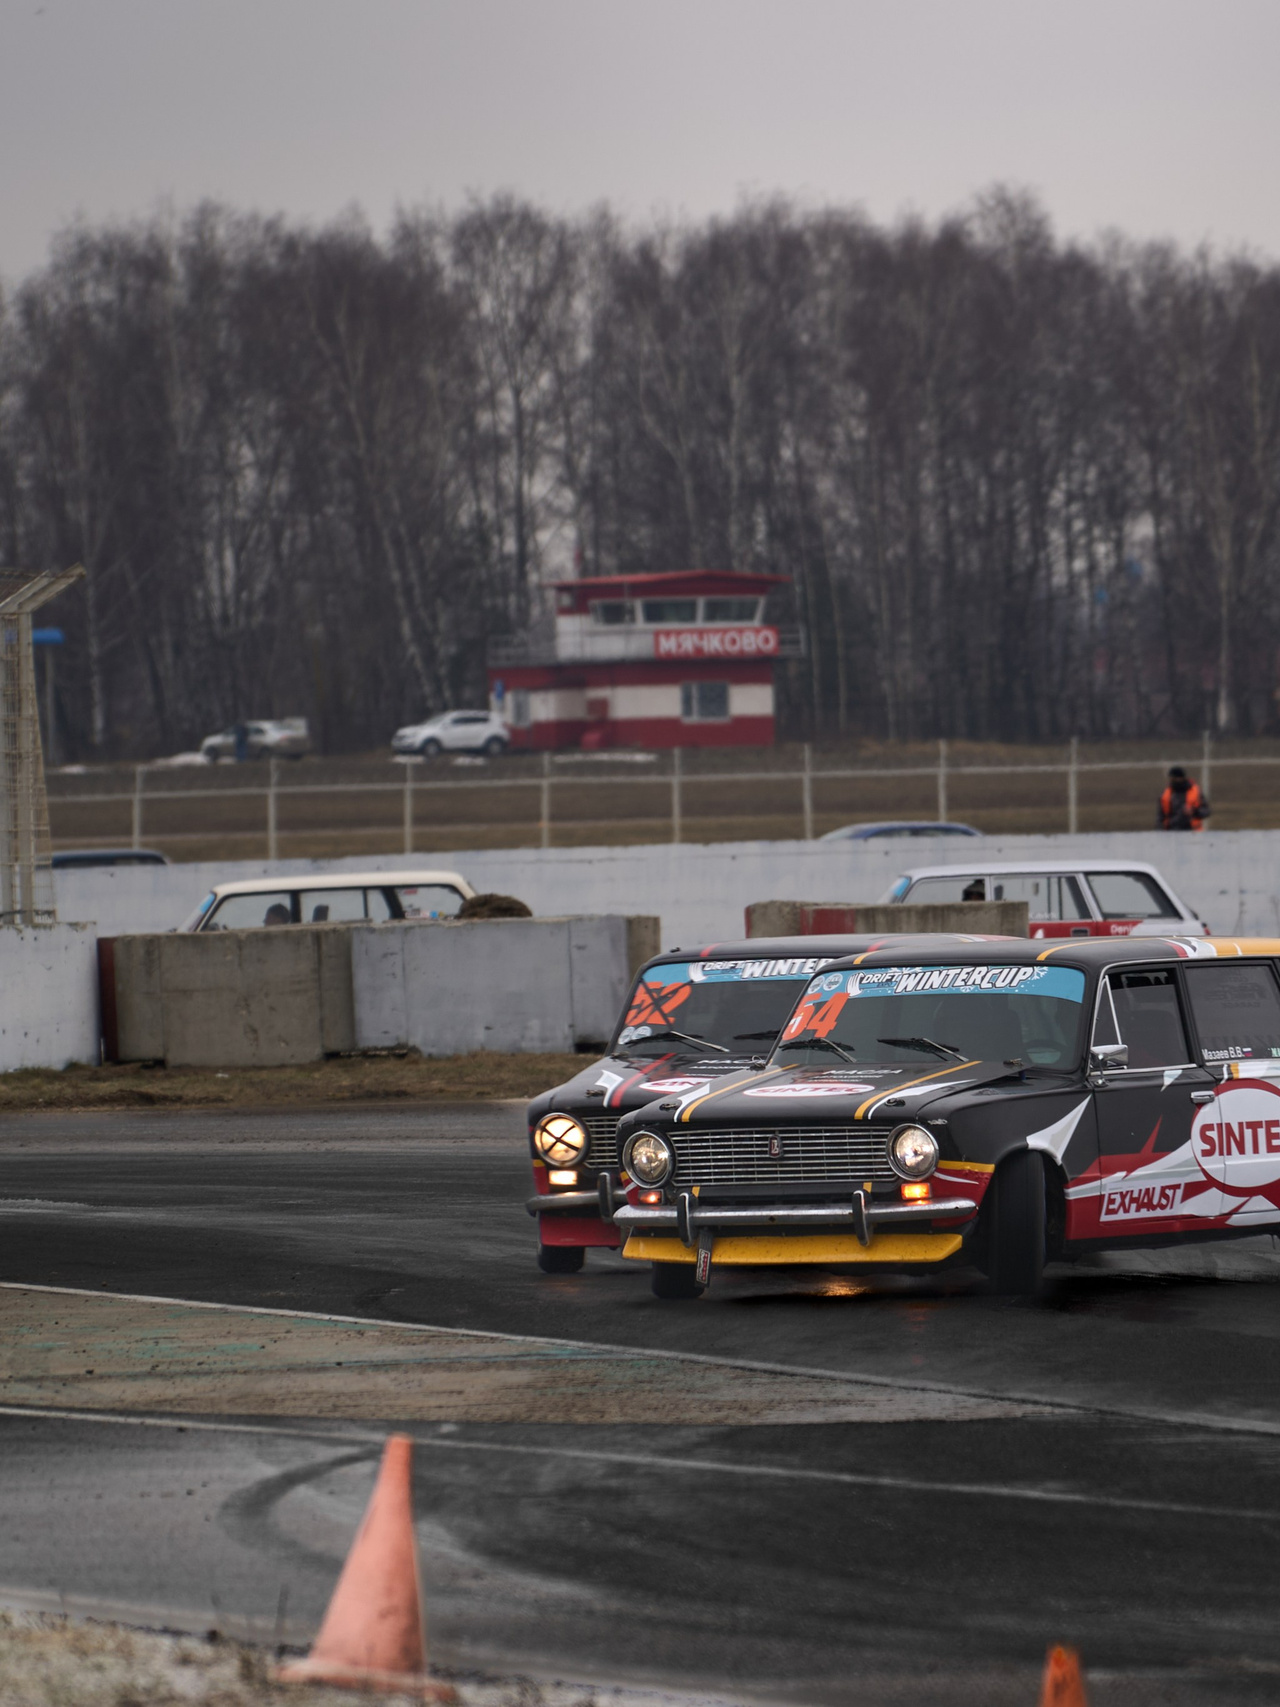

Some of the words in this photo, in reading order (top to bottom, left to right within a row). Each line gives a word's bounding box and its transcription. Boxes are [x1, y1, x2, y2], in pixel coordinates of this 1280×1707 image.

[658, 629, 776, 655] МЯЧКОВО
[703, 961, 743, 971] DRIFT
[860, 972, 903, 985] DRIFT
[626, 982, 692, 1026] 52
[781, 992, 850, 1041] 54
[750, 1086, 868, 1094] SINTEC
[1104, 1183, 1182, 1216] EXHAUST
